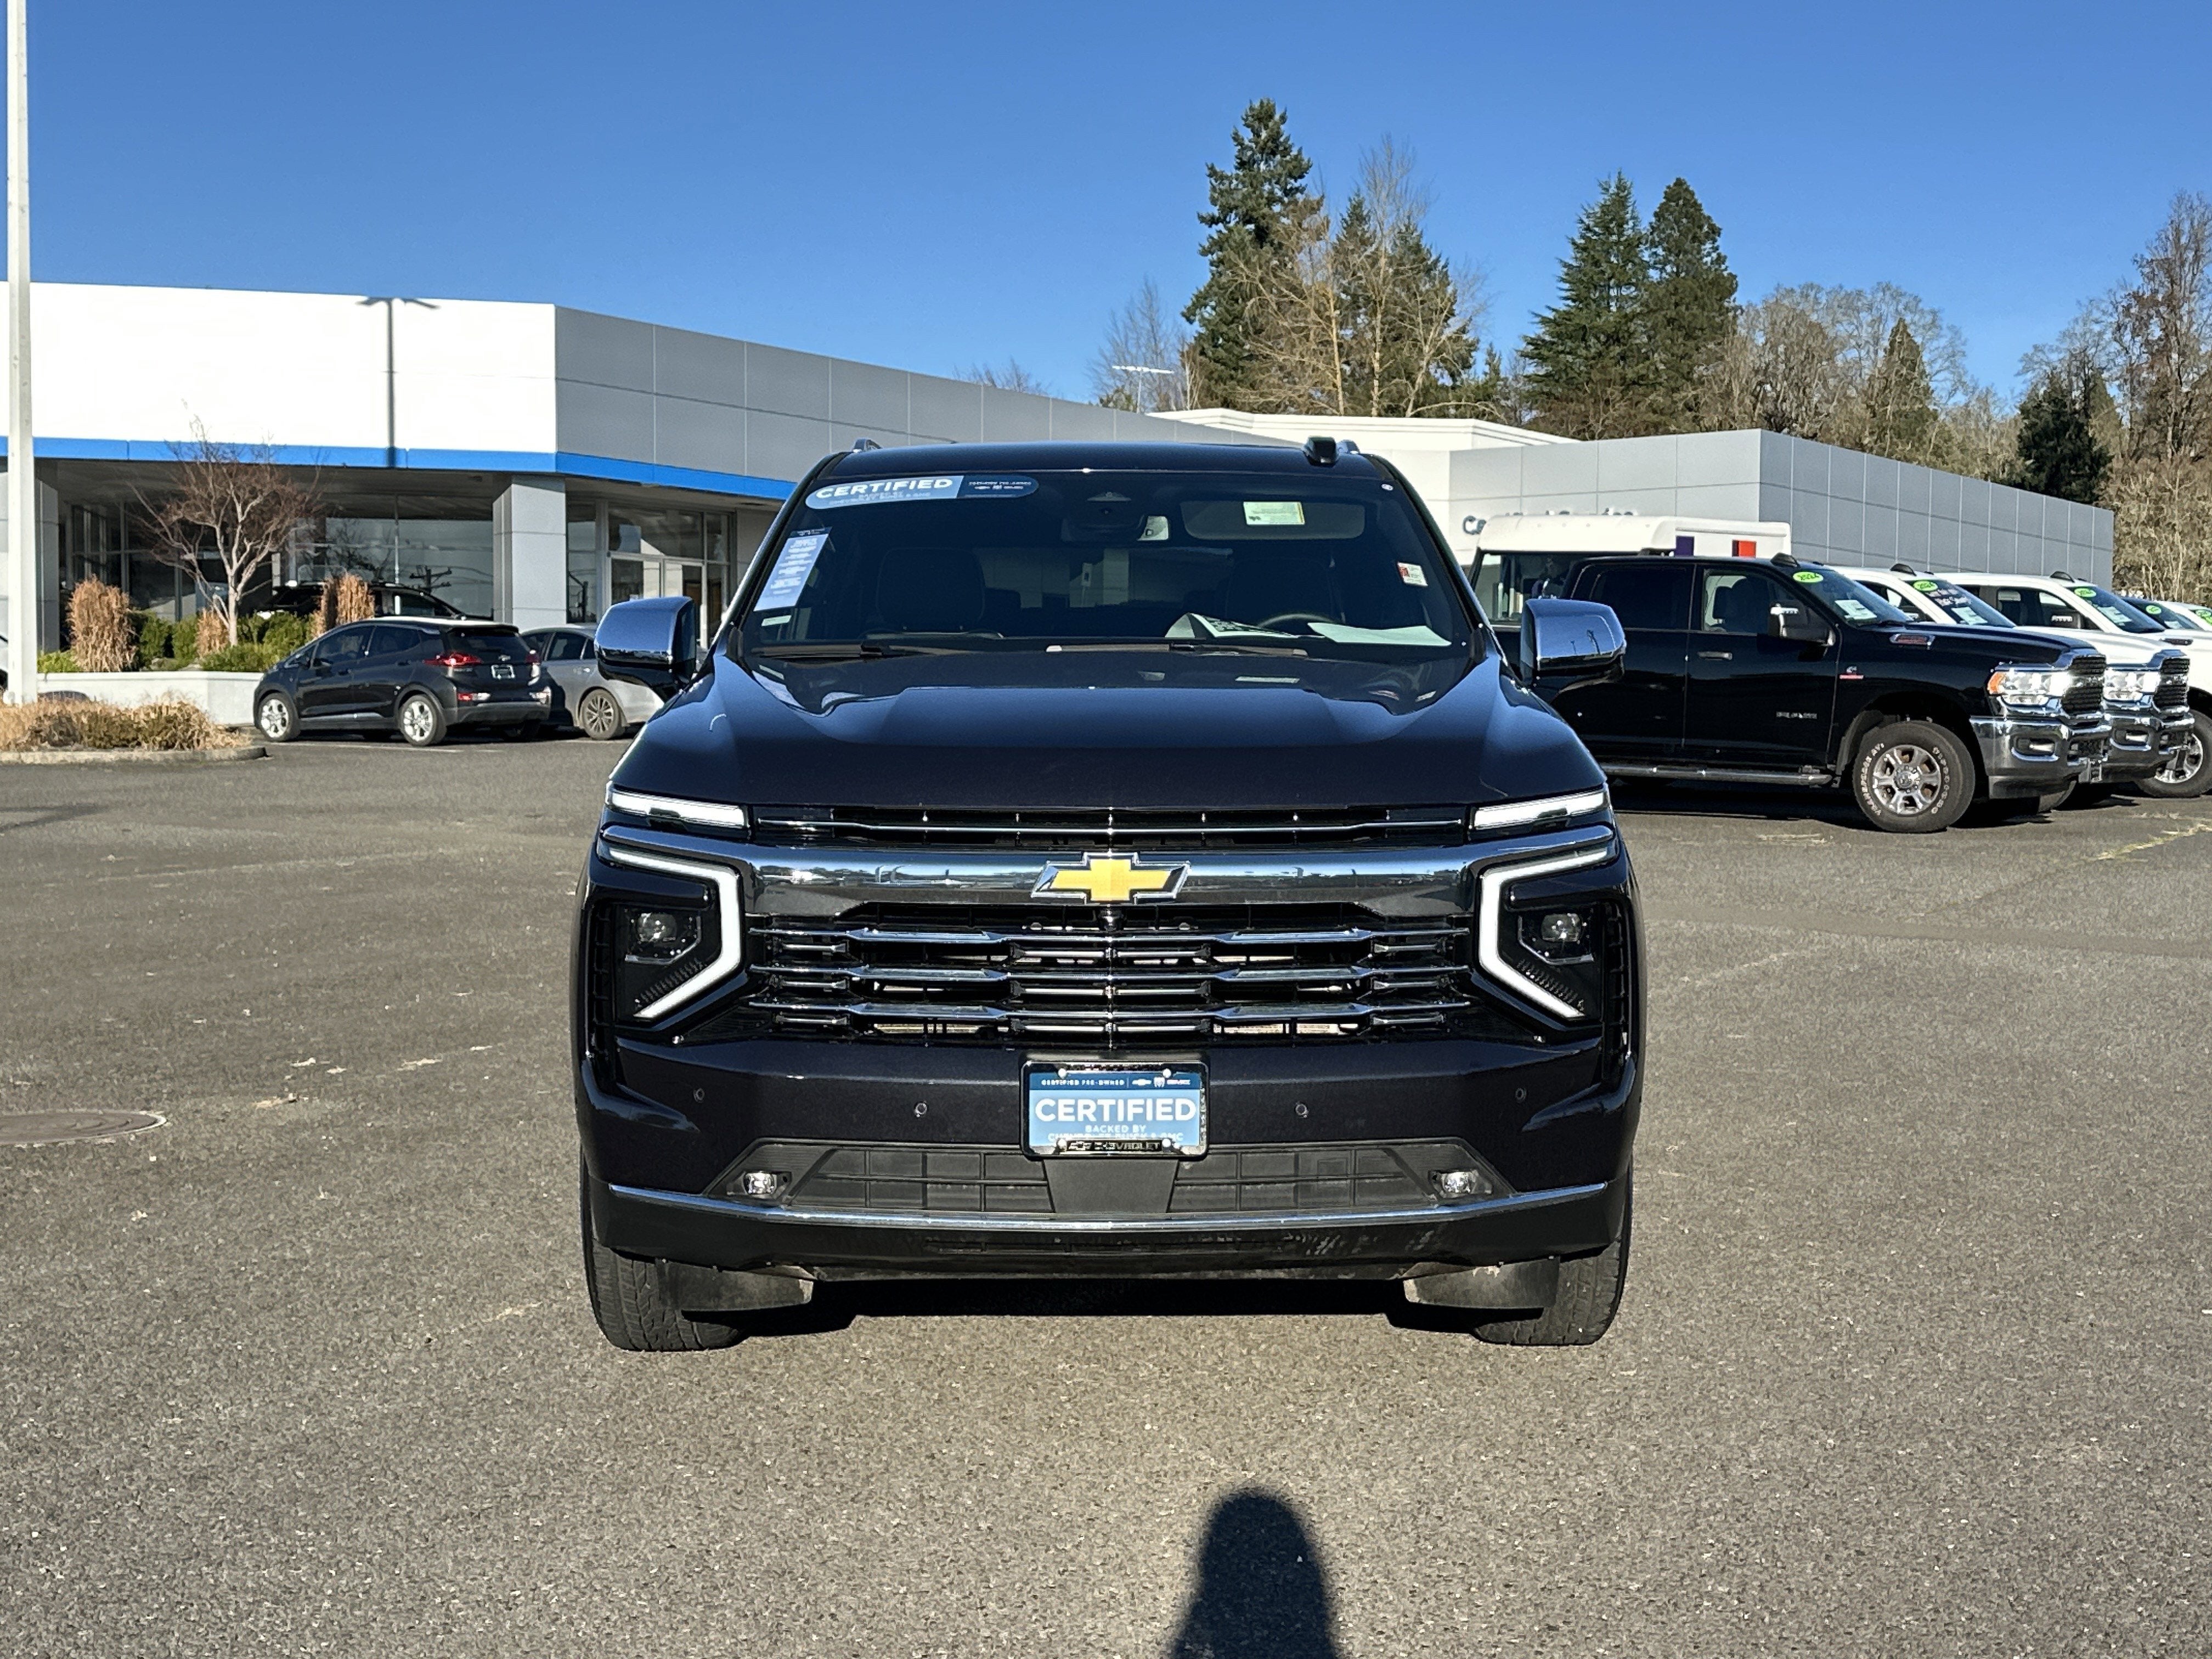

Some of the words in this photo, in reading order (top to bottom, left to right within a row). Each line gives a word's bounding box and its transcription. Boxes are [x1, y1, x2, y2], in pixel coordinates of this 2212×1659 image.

[816, 478, 953, 499] CERTIFIED
[1035, 1098, 1197, 1122] CERTIFIED
[1085, 1125, 1129, 1133] BACKED
[1132, 1124, 1146, 1133] BY
